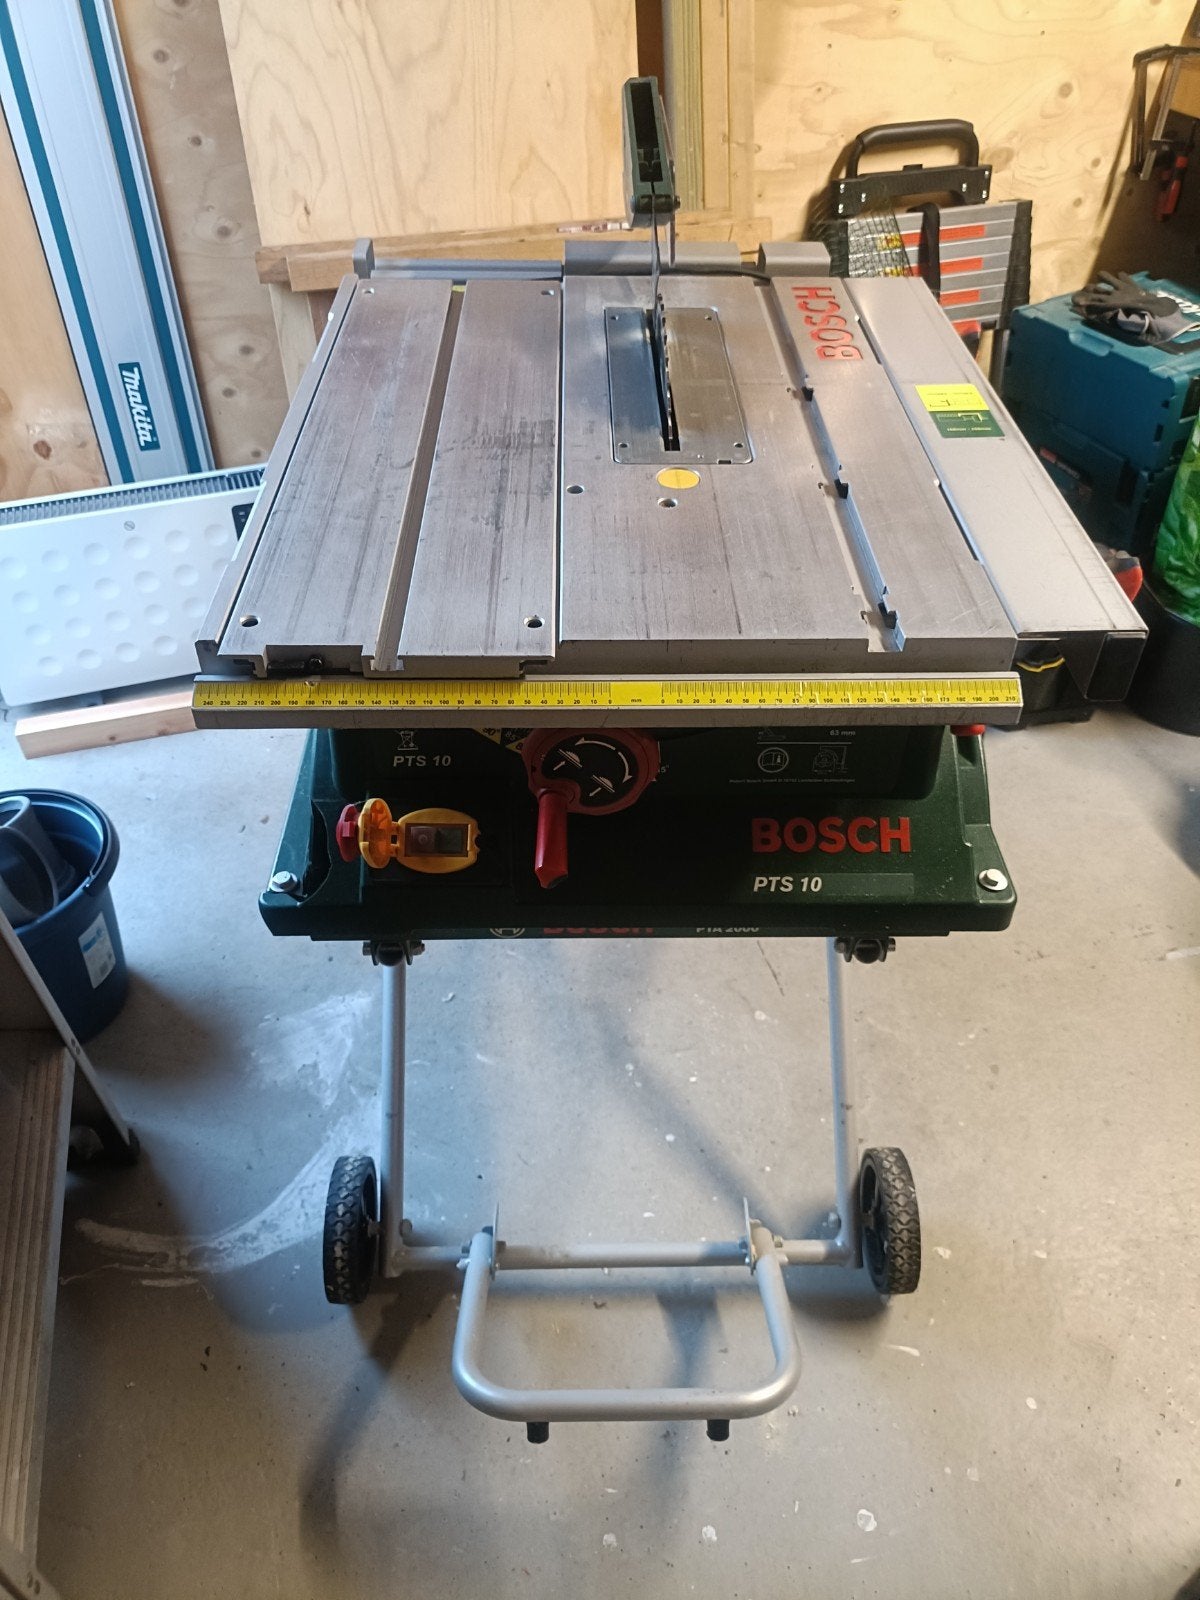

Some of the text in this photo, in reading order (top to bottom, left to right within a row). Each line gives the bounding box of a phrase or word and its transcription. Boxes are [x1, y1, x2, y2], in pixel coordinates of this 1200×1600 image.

[791, 286, 863, 360] BOSCH
[393, 755, 452, 766] PTS 10
[752, 816, 912, 854] BOSCH
[753, 876, 823, 892] PTS 10
